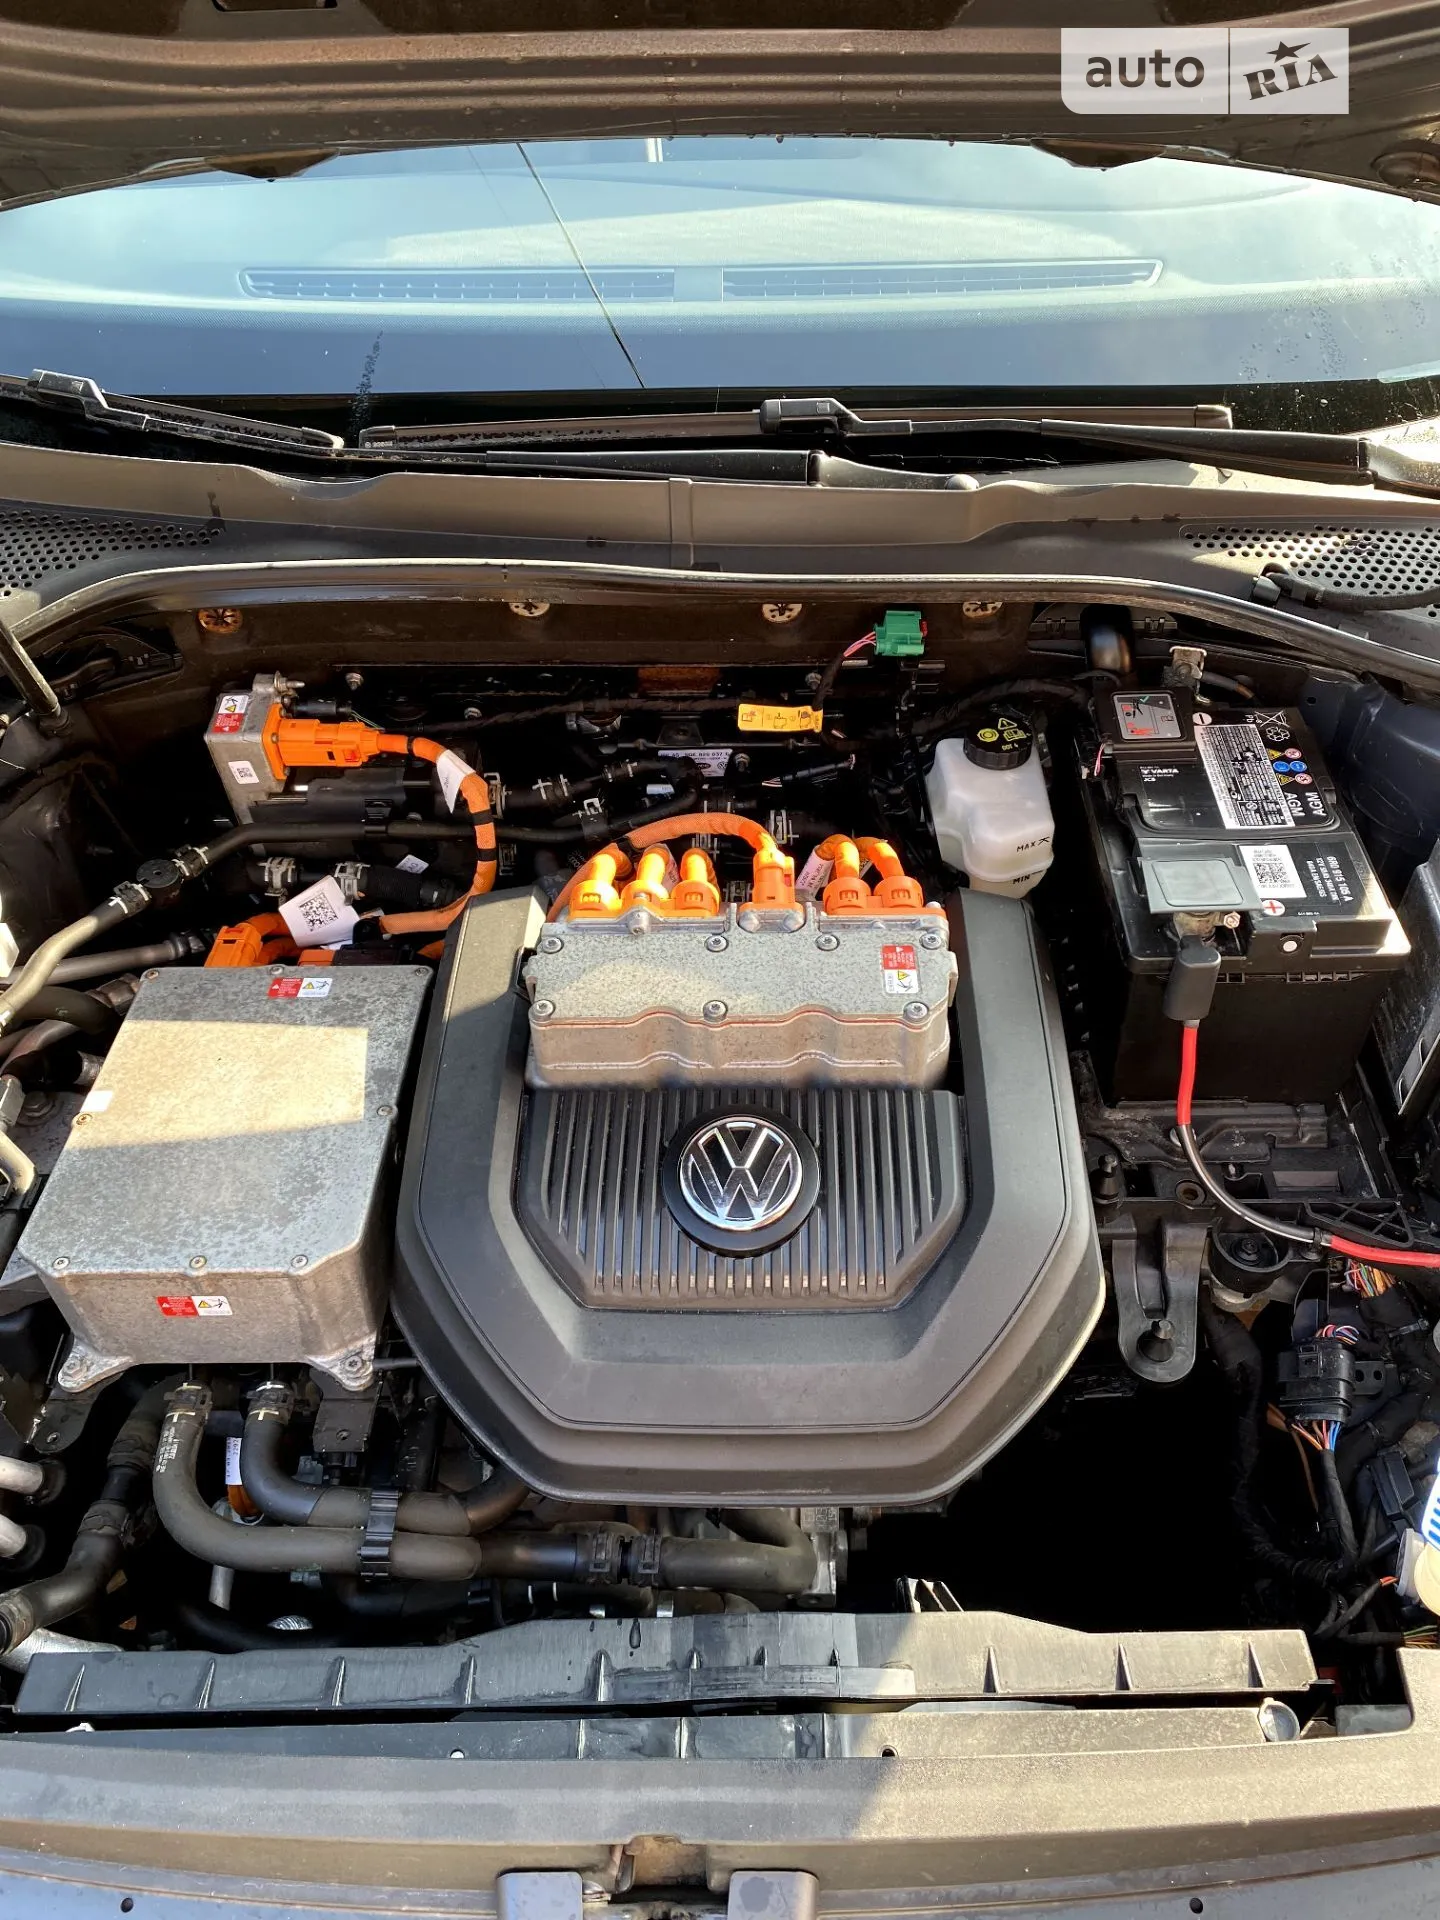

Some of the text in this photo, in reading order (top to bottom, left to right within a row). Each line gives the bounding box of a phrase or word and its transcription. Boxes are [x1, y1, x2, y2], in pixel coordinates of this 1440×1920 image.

[1284, 791, 1306, 817] AGM
[1305, 791, 1327, 817] AGM
[1016, 840, 1036, 852] MAX
[1012, 874, 1031, 885] MIN
